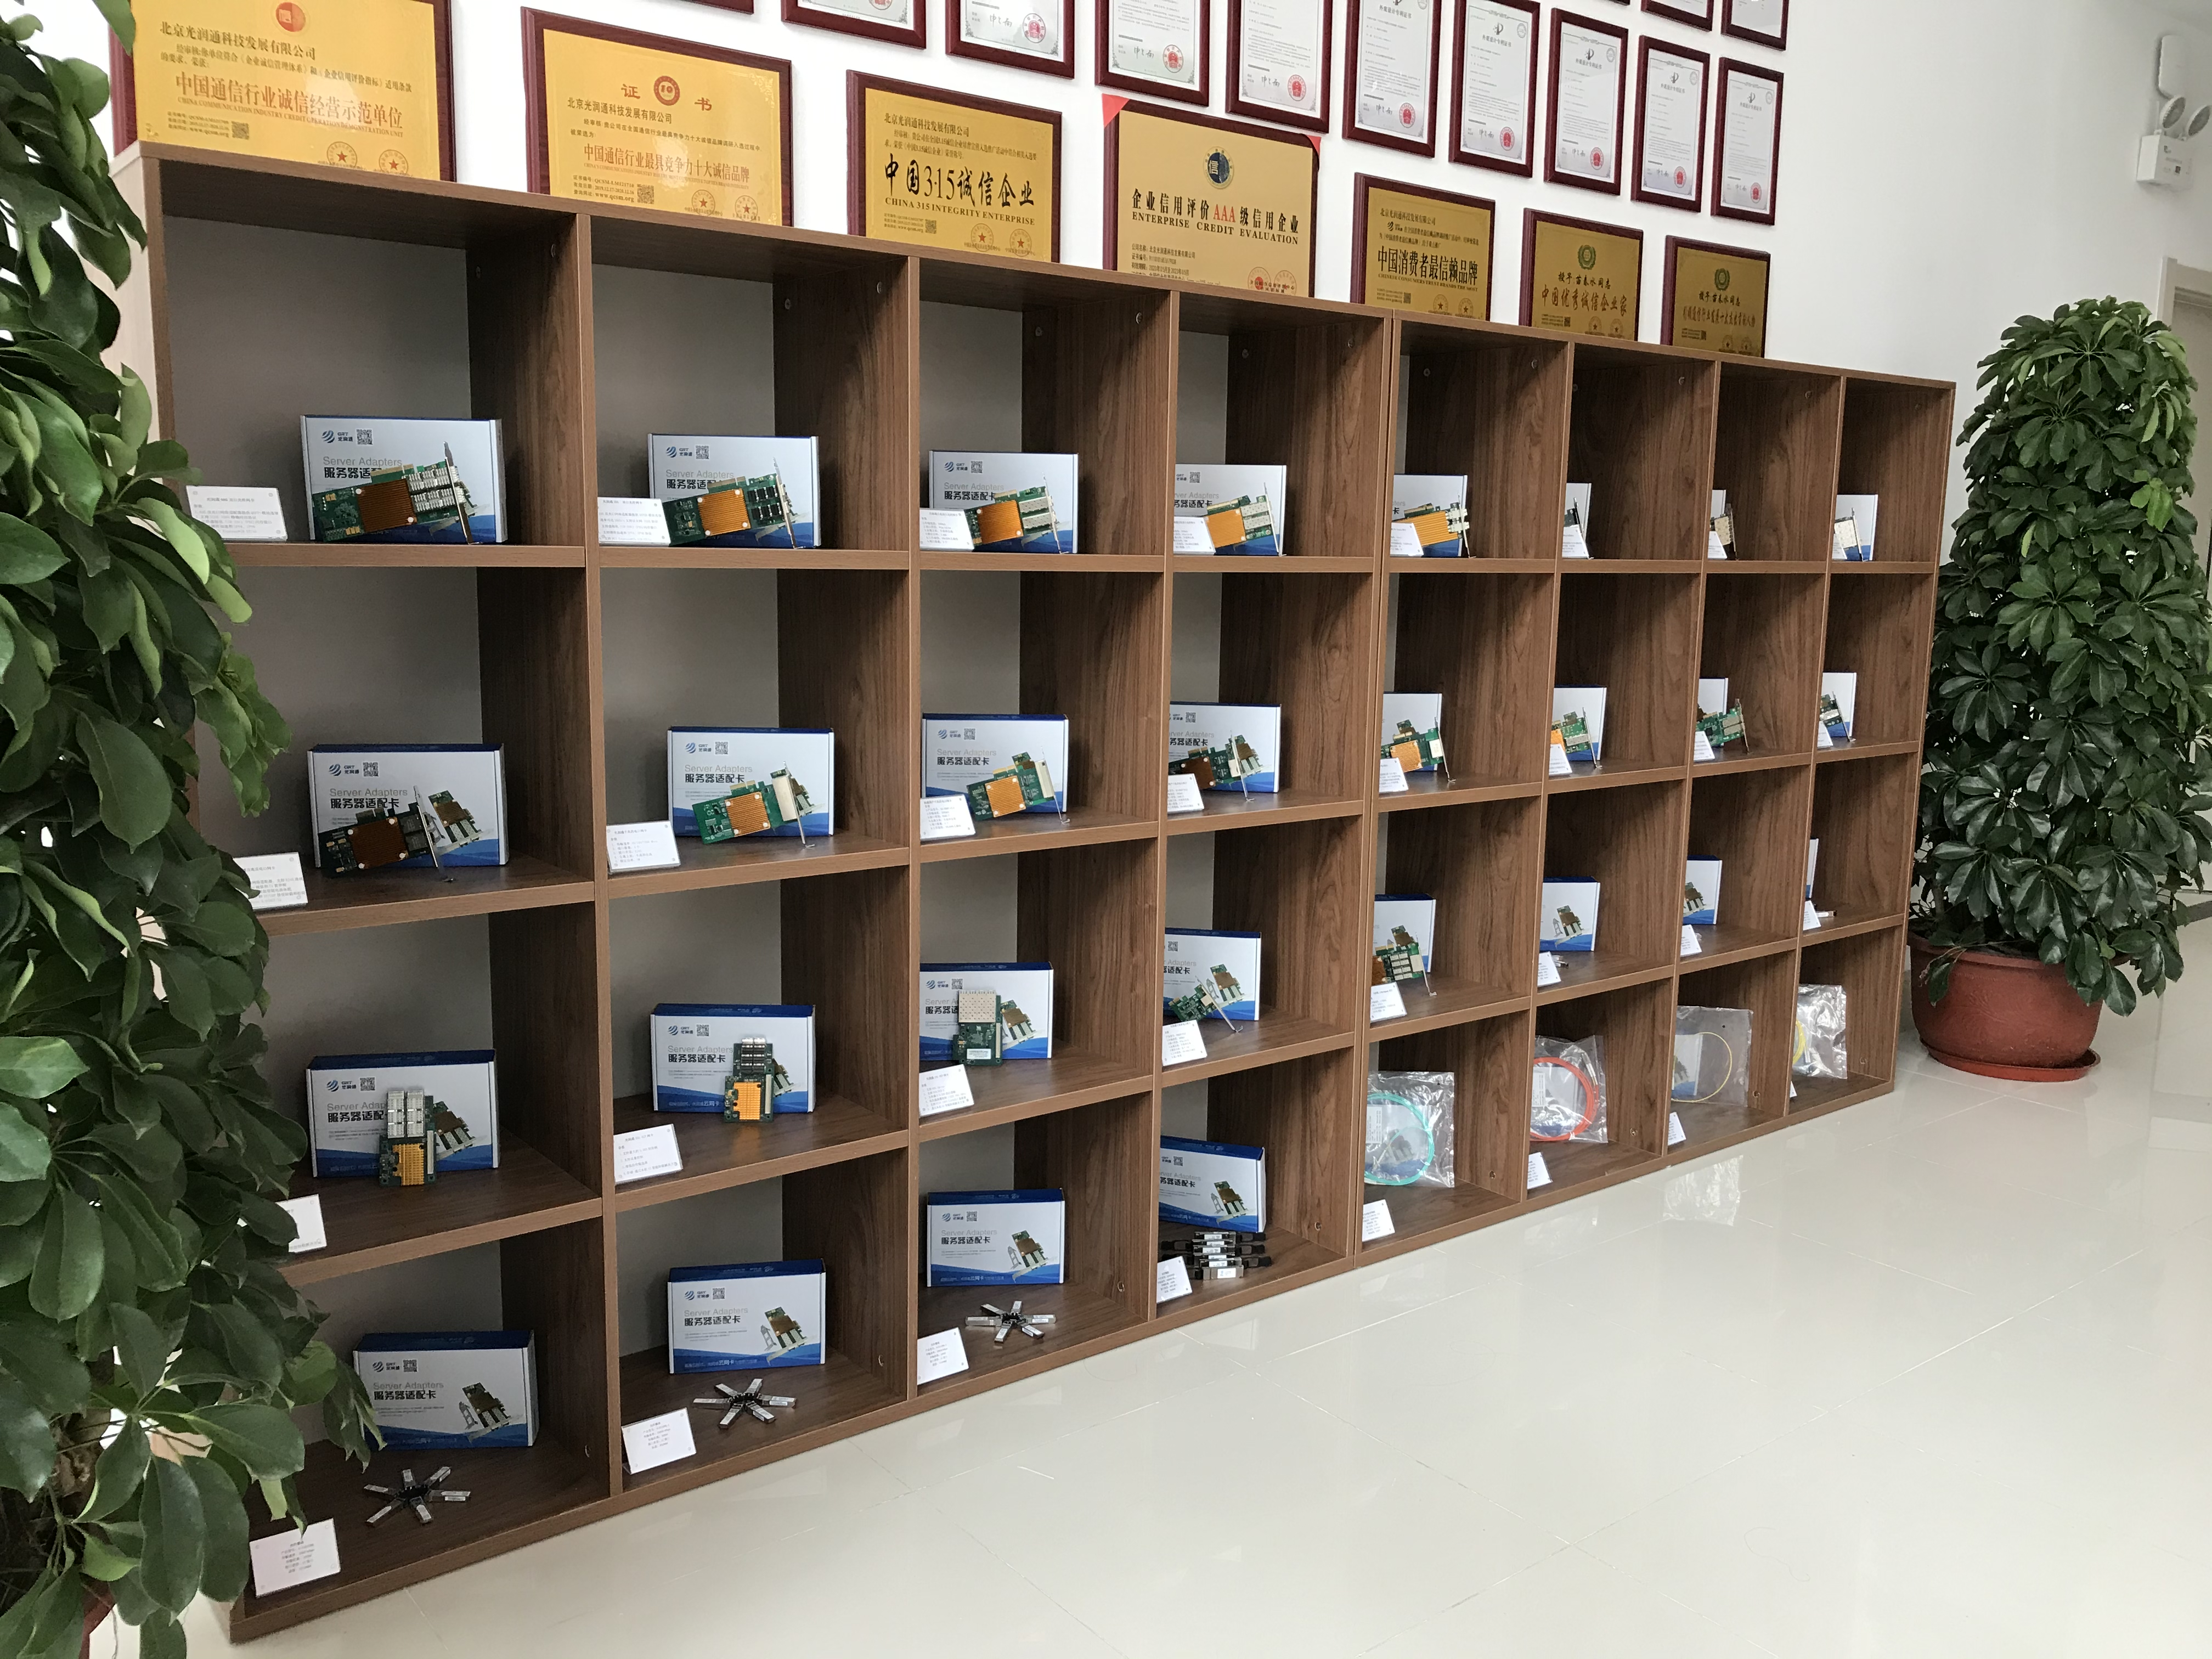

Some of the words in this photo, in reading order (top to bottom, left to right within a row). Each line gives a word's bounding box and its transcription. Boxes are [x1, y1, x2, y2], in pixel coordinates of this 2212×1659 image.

[160, 21, 315, 60] 北京光润通科技发展有限公司
[176, 71, 403, 129] 中国通信行业诚信经营示范单位
[621, 83, 640, 99] 证
[695, 97, 712, 111] 书
[178, 96, 198, 106] CHINA
[253, 108, 283, 119] INDUSTRY
[284, 113, 306, 122] CREDIT
[567, 97, 672, 124] 北京光润通科技发展有限公司
[884, 113, 969, 137] 北京光润通科技发展有限公司
[584, 143, 749, 183] 中国通信行业最具竞争力十大诚信品牌
[1209, 160, 1219, 175] 信
[595, 193, 634, 202] www.qcsm.org
[885, 197, 914, 208] CHINA
[916, 201, 929, 210] 315
[932, 204, 980, 217] INTEGRITY
[983, 211, 1035, 225] ENTERPRISE
[1132, 211, 1189, 229] ENTERPRISE
[1197, 221, 1234, 235] CREDIT
[1239, 229, 1298, 245] EVALUATION
[1378, 245, 1478, 286] 中国消费者最信赖品牌
[1398, 276, 1425, 284] CONSUMERS
[323, 456, 357, 466] Server
[359, 456, 402, 468] Adapters
[324, 467, 381, 479] 服务器适
[666, 470, 694, 478] Server
[697, 470, 734, 479] Adapters
[971, 483, 1004, 492] Adapters
[1175, 500, 1212, 508] 务器适配卡
[1170, 738, 1208, 746] 务器适配卡
[937, 757, 989, 766] 服务器适配卡
[715, 765, 752, 774] Adapters
[685, 774, 744, 784] 服务器适配卡
[330, 788, 362, 797] Server
[364, 788, 408, 798] Adapters
[330, 798, 399, 809] 服务器适配卡
[1164, 966, 1190, 974] 适配卡
[926, 1006, 959, 1014] 服务器适
[697, 1046, 733, 1054] Adapters
[668, 1054, 726, 1063] 服务器适配卡
[327, 1103, 358, 1111] Server
[362, 1102, 387, 1111] Adap
[328, 1111, 387, 1123] 服务器适配
[1160, 1177, 1195, 1187] 务器适配卡
[1174, 1173, 1201, 1181] Adapters
[941, 1237, 990, 1245] 服务器适配卡
[684, 1308, 711, 1317] Server
[713, 1307, 748, 1316] Adapters
[684, 1316, 741, 1327] 服务器适配卡
[405, 1381, 444, 1390] Adapters
[374, 1390, 436, 1401] 服务器适配卡
